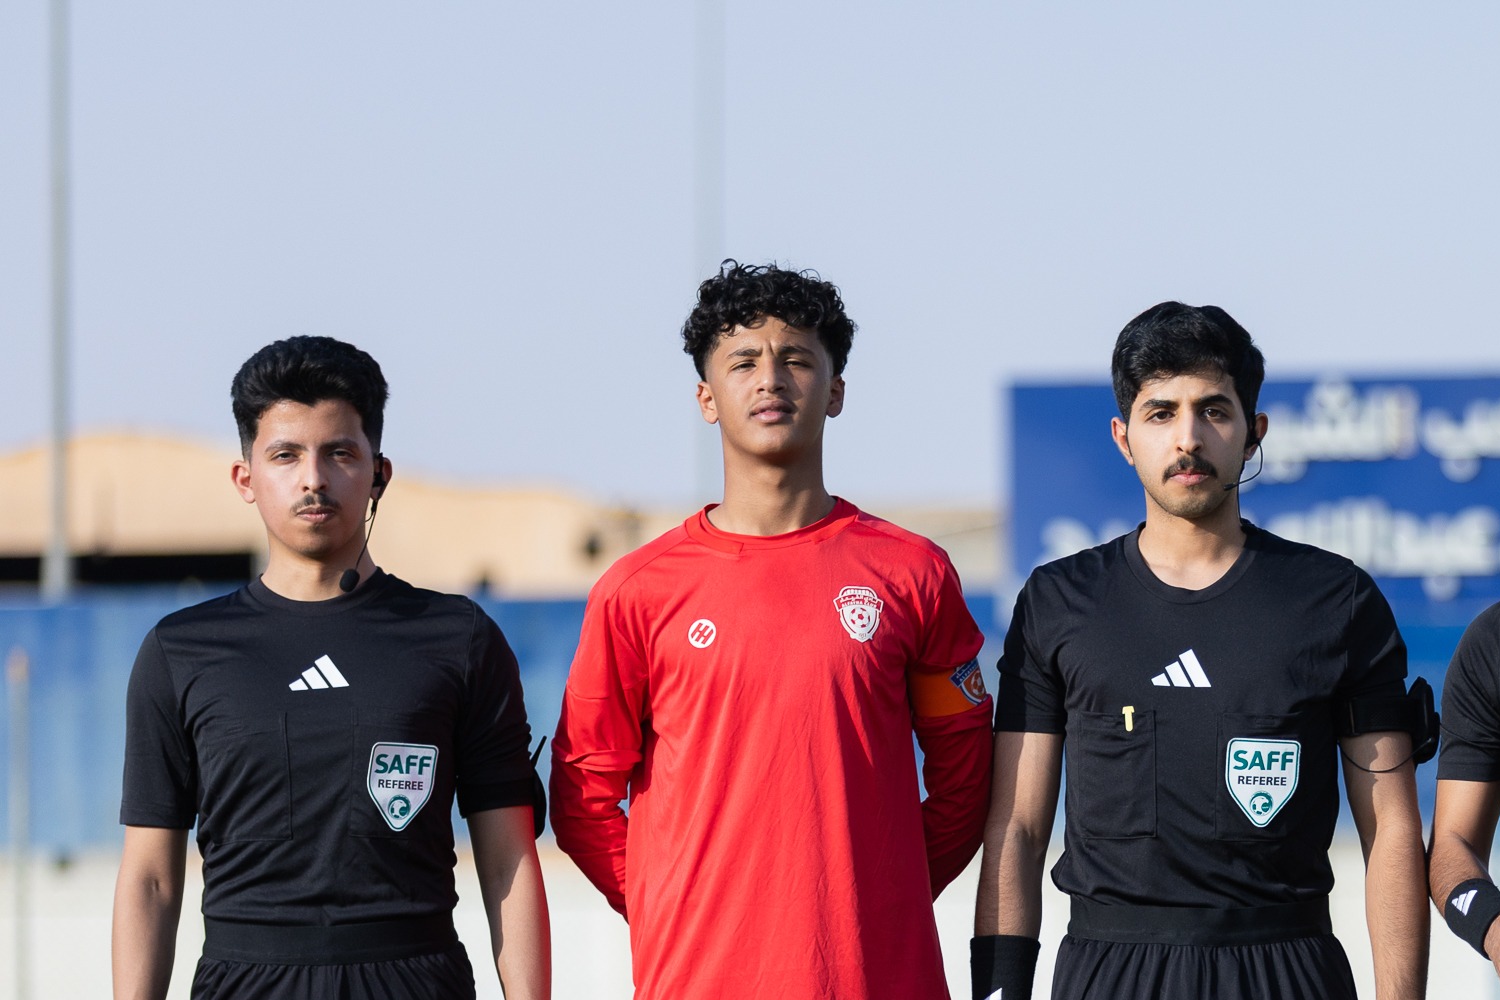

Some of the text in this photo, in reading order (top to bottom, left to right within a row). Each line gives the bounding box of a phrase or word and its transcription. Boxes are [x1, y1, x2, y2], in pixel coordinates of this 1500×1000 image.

[374, 753, 432, 776] SAFF
[1233, 749, 1295, 771] SAFF
[377, 778, 424, 791] REFEREE
[1237, 775, 1287, 786] REFEREE
